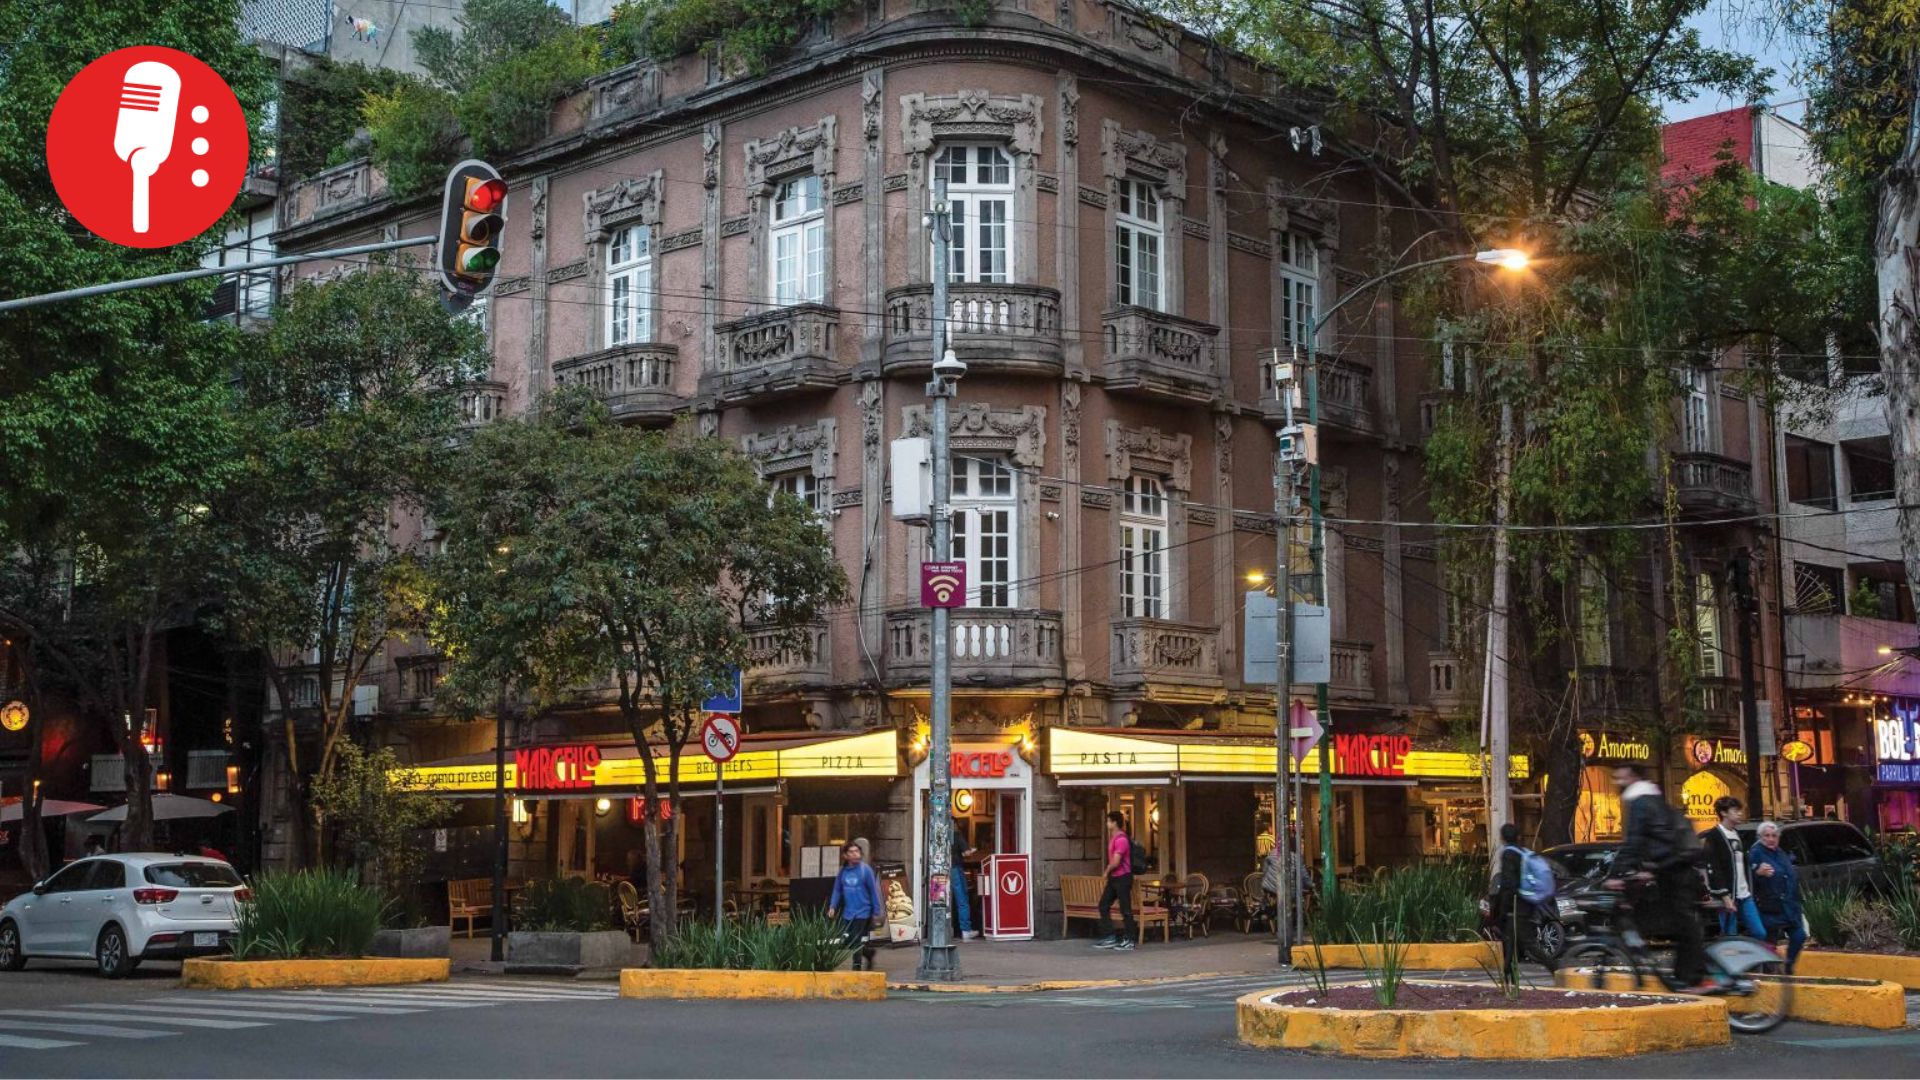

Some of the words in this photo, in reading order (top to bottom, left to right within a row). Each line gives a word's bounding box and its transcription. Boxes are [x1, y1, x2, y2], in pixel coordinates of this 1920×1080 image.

[1335, 734, 1411, 776] MARCELLO
[1598, 733, 1650, 760] Amorino
[515, 744, 602, 789] MARCELLO
[821, 755, 864, 769] PIZZA
[949, 751, 1014, 778] RCELLO
[1080, 751, 1138, 765] PASTA
[457, 769, 512, 787] presena
[1881, 764, 1911, 782] PARRILLA
